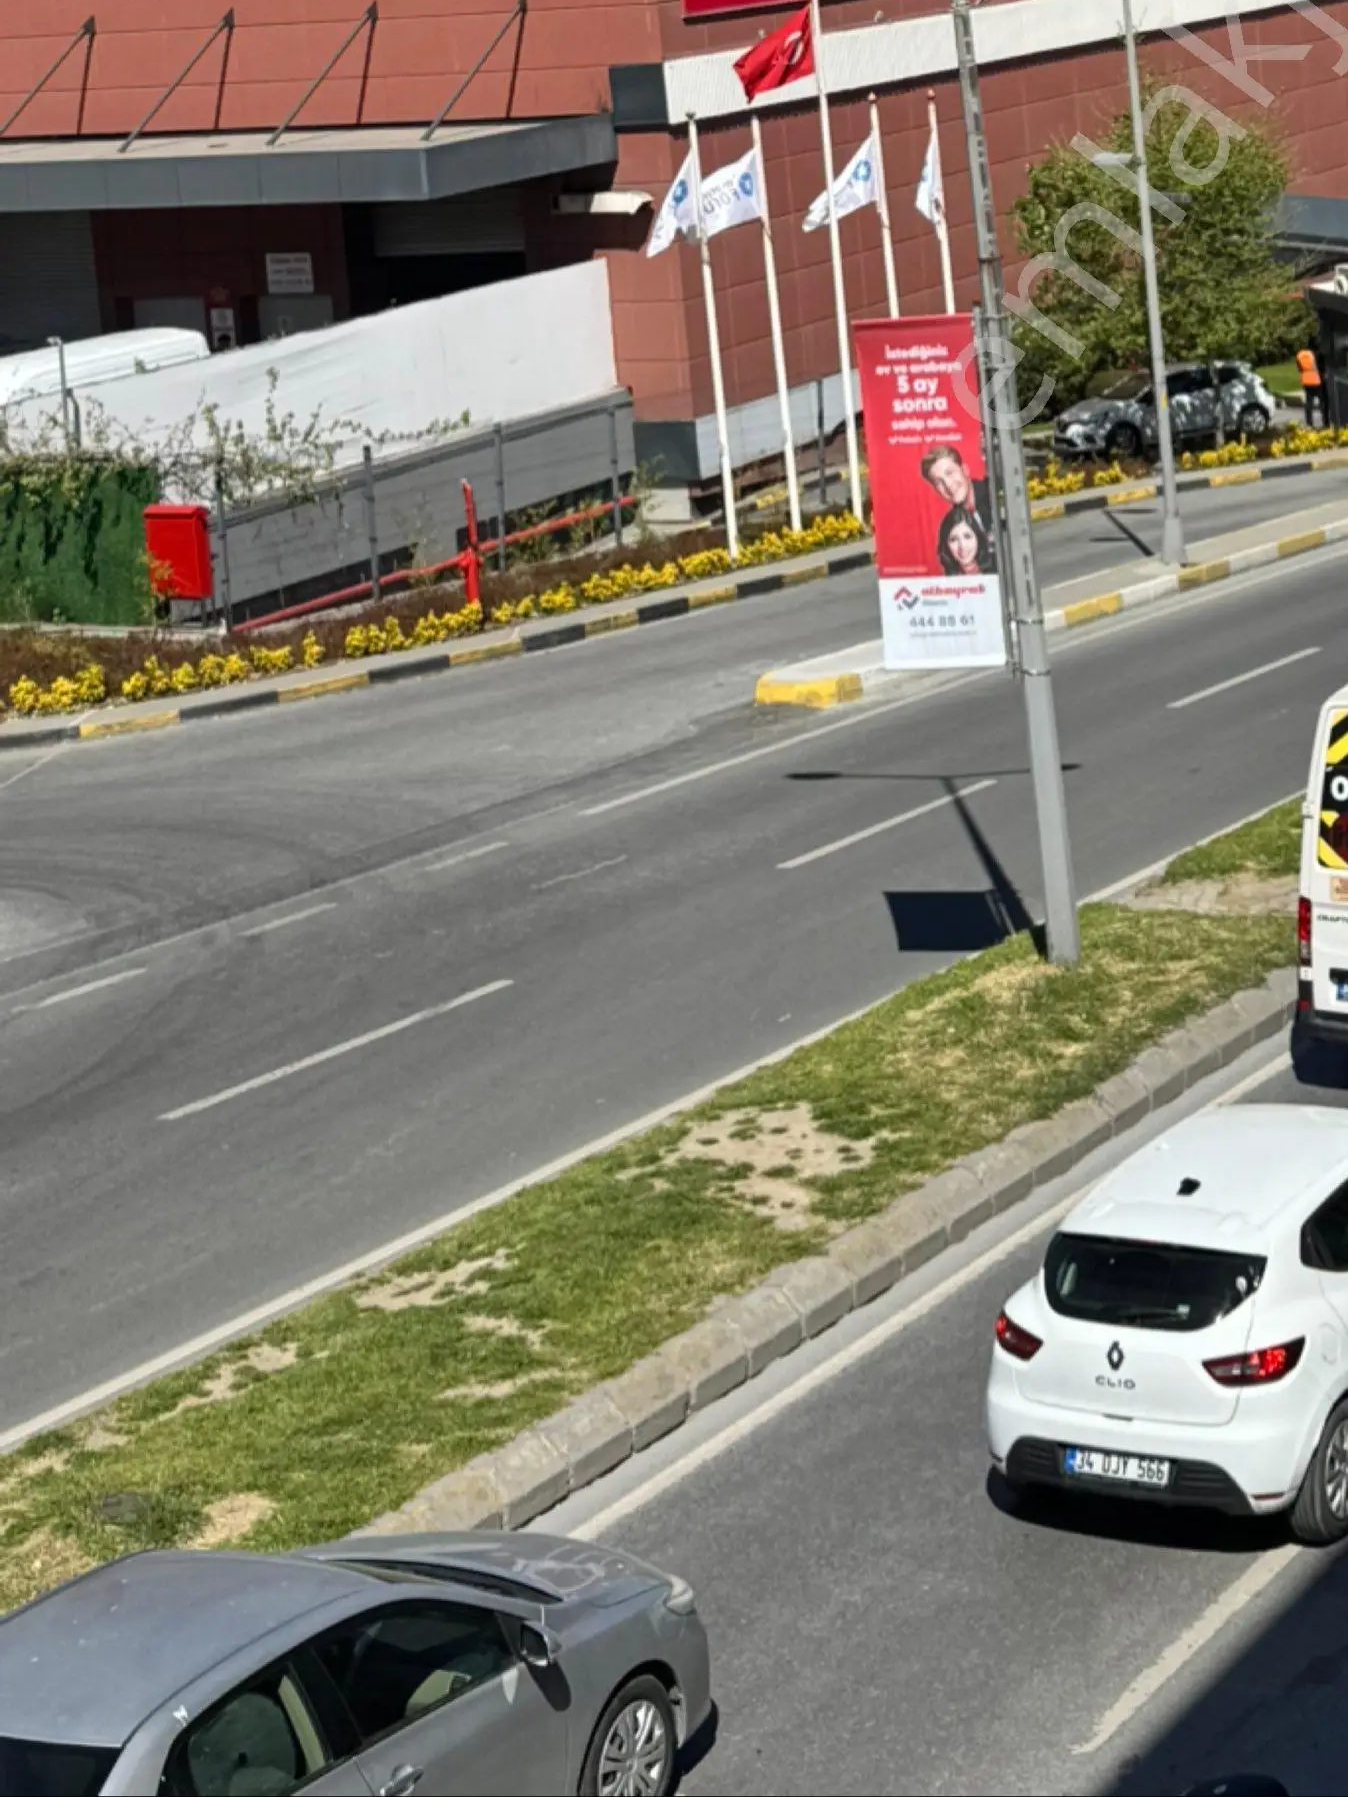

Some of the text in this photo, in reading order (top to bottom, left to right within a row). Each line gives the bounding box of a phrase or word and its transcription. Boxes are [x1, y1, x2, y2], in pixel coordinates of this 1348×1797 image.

[913, 377, 938, 396] ay
[892, 396, 948, 413] sonra
[1095, 1376, 1136, 1391] CLIO
[1077, 1451, 1093, 1472] 34
